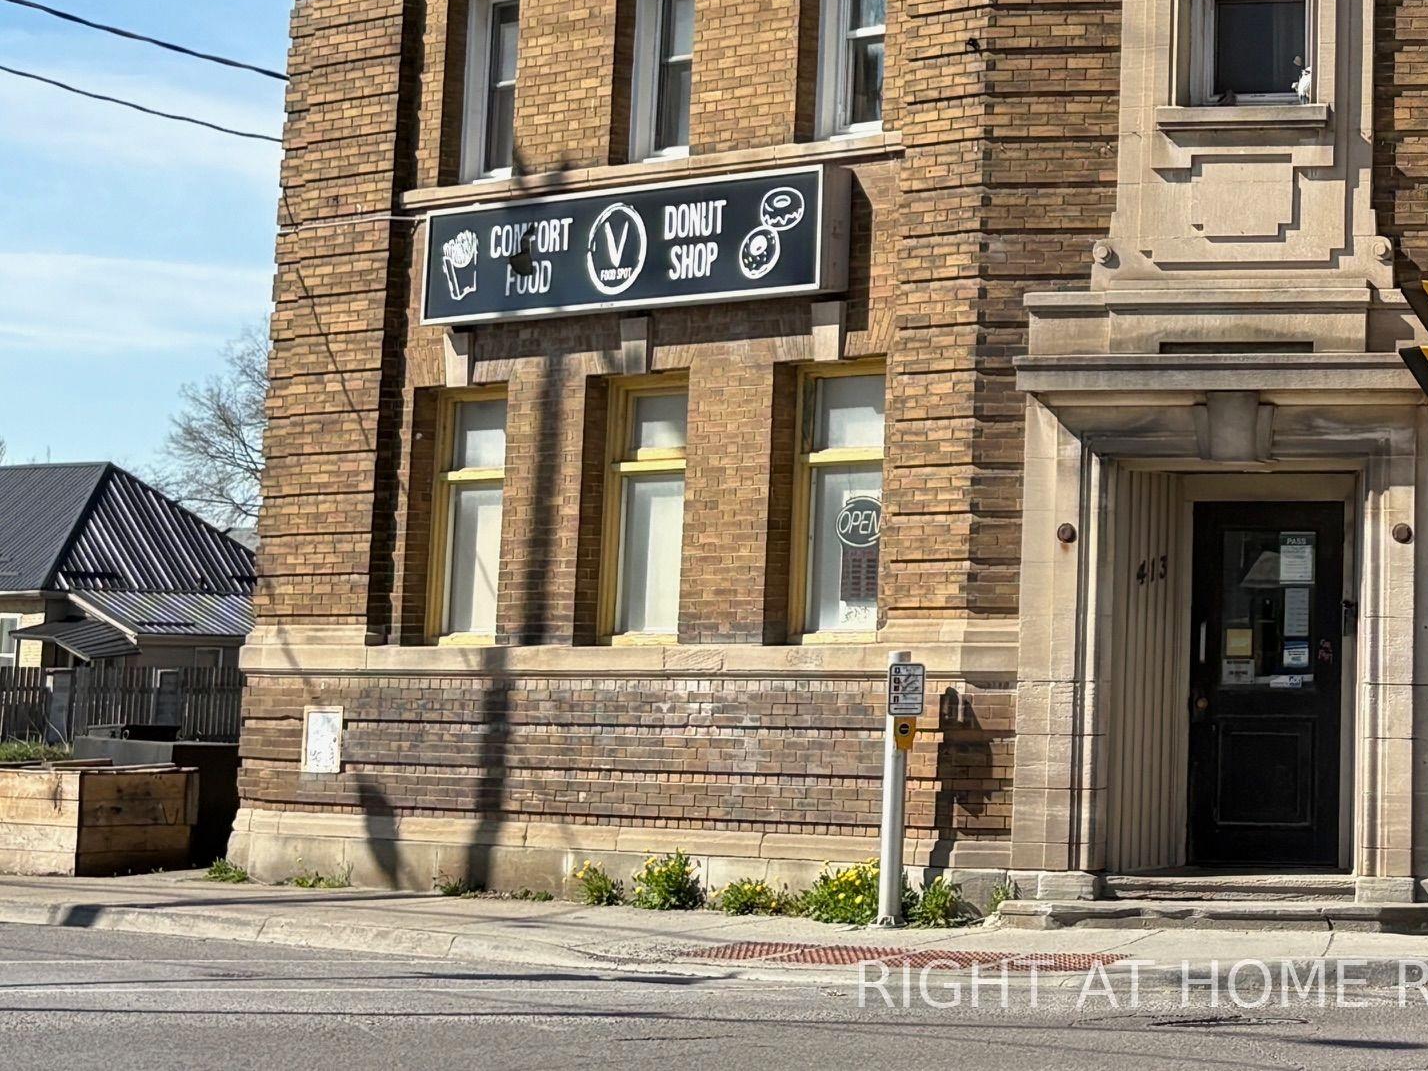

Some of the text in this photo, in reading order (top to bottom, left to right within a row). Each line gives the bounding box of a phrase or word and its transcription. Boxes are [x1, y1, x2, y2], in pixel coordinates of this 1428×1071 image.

[664, 199, 727, 240] DONUT
[604, 220, 629, 267] V
[600, 267, 632, 281] FOOD SPOT
[669, 242, 719, 280] SHOP
[838, 509, 881, 535] OPEN
[1286, 537, 1307, 545] PASS
[1136, 555, 1168, 585] 413
